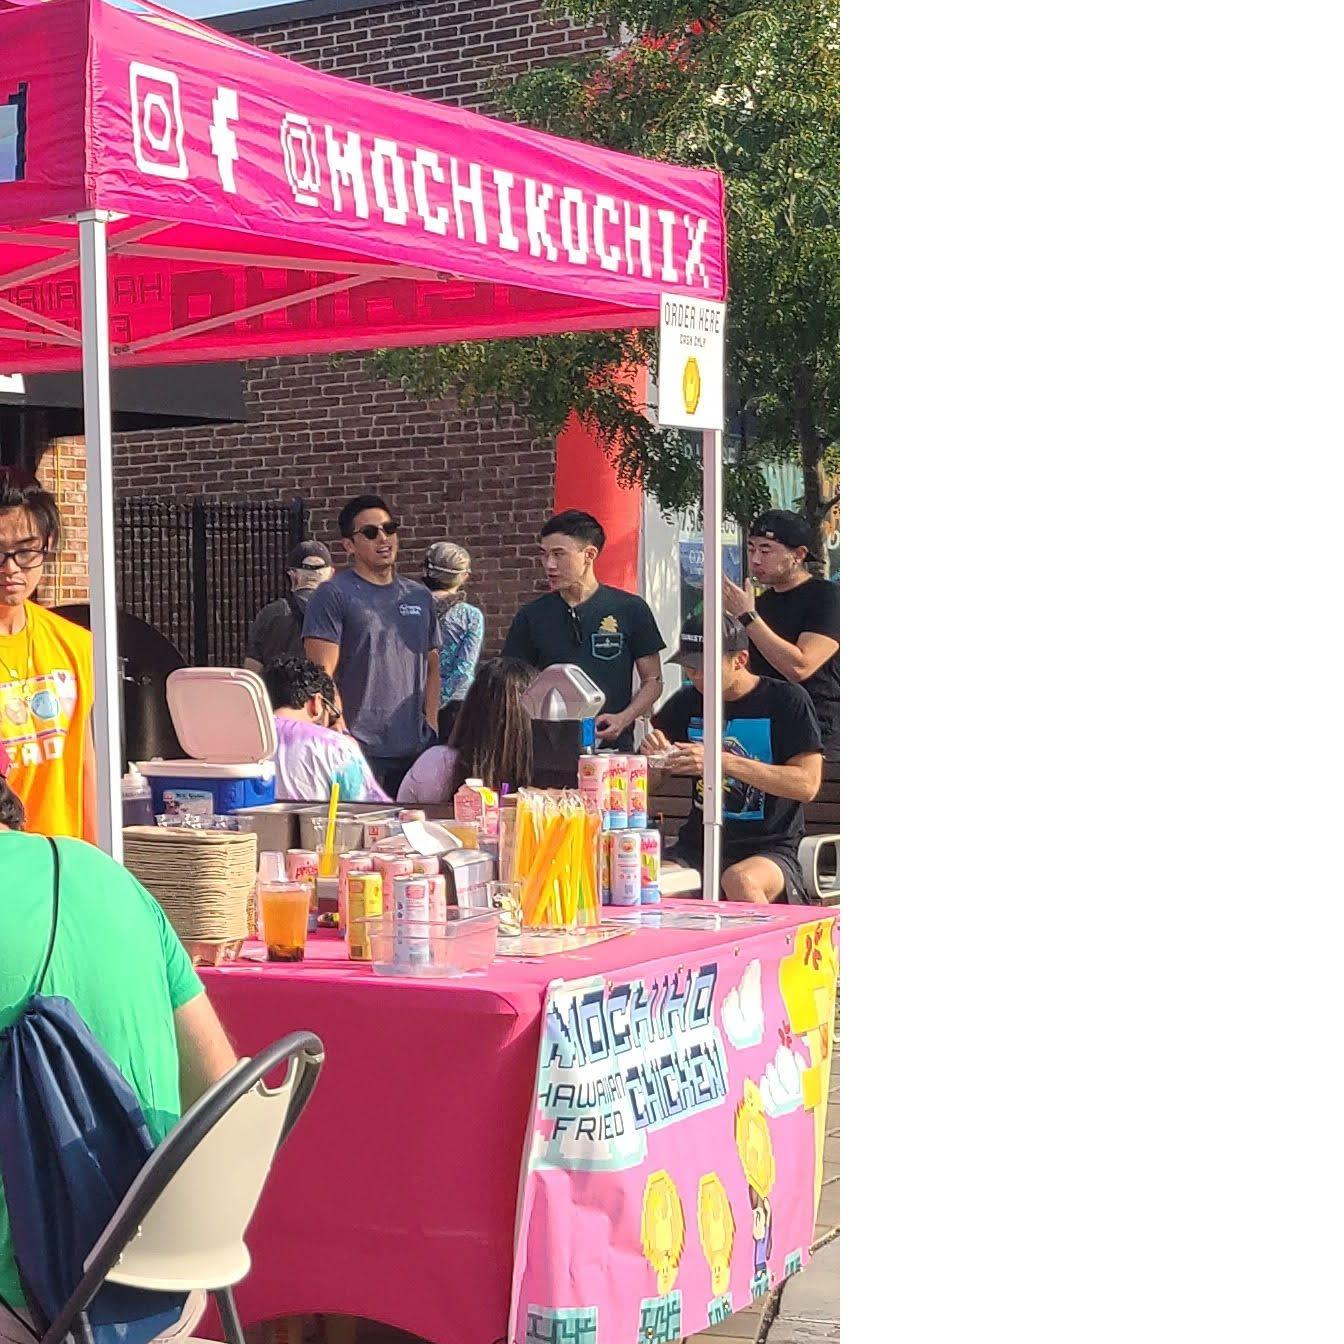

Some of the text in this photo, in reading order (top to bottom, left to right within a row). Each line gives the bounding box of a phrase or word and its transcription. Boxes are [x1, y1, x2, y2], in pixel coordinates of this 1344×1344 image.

[280, 112, 709, 288] @MOCHIKOCHIX
[664, 302, 721, 334] ORDER HERE
[625, 1039, 727, 1131] CHICKEN
[552, 1110, 625, 1142] FRIED
